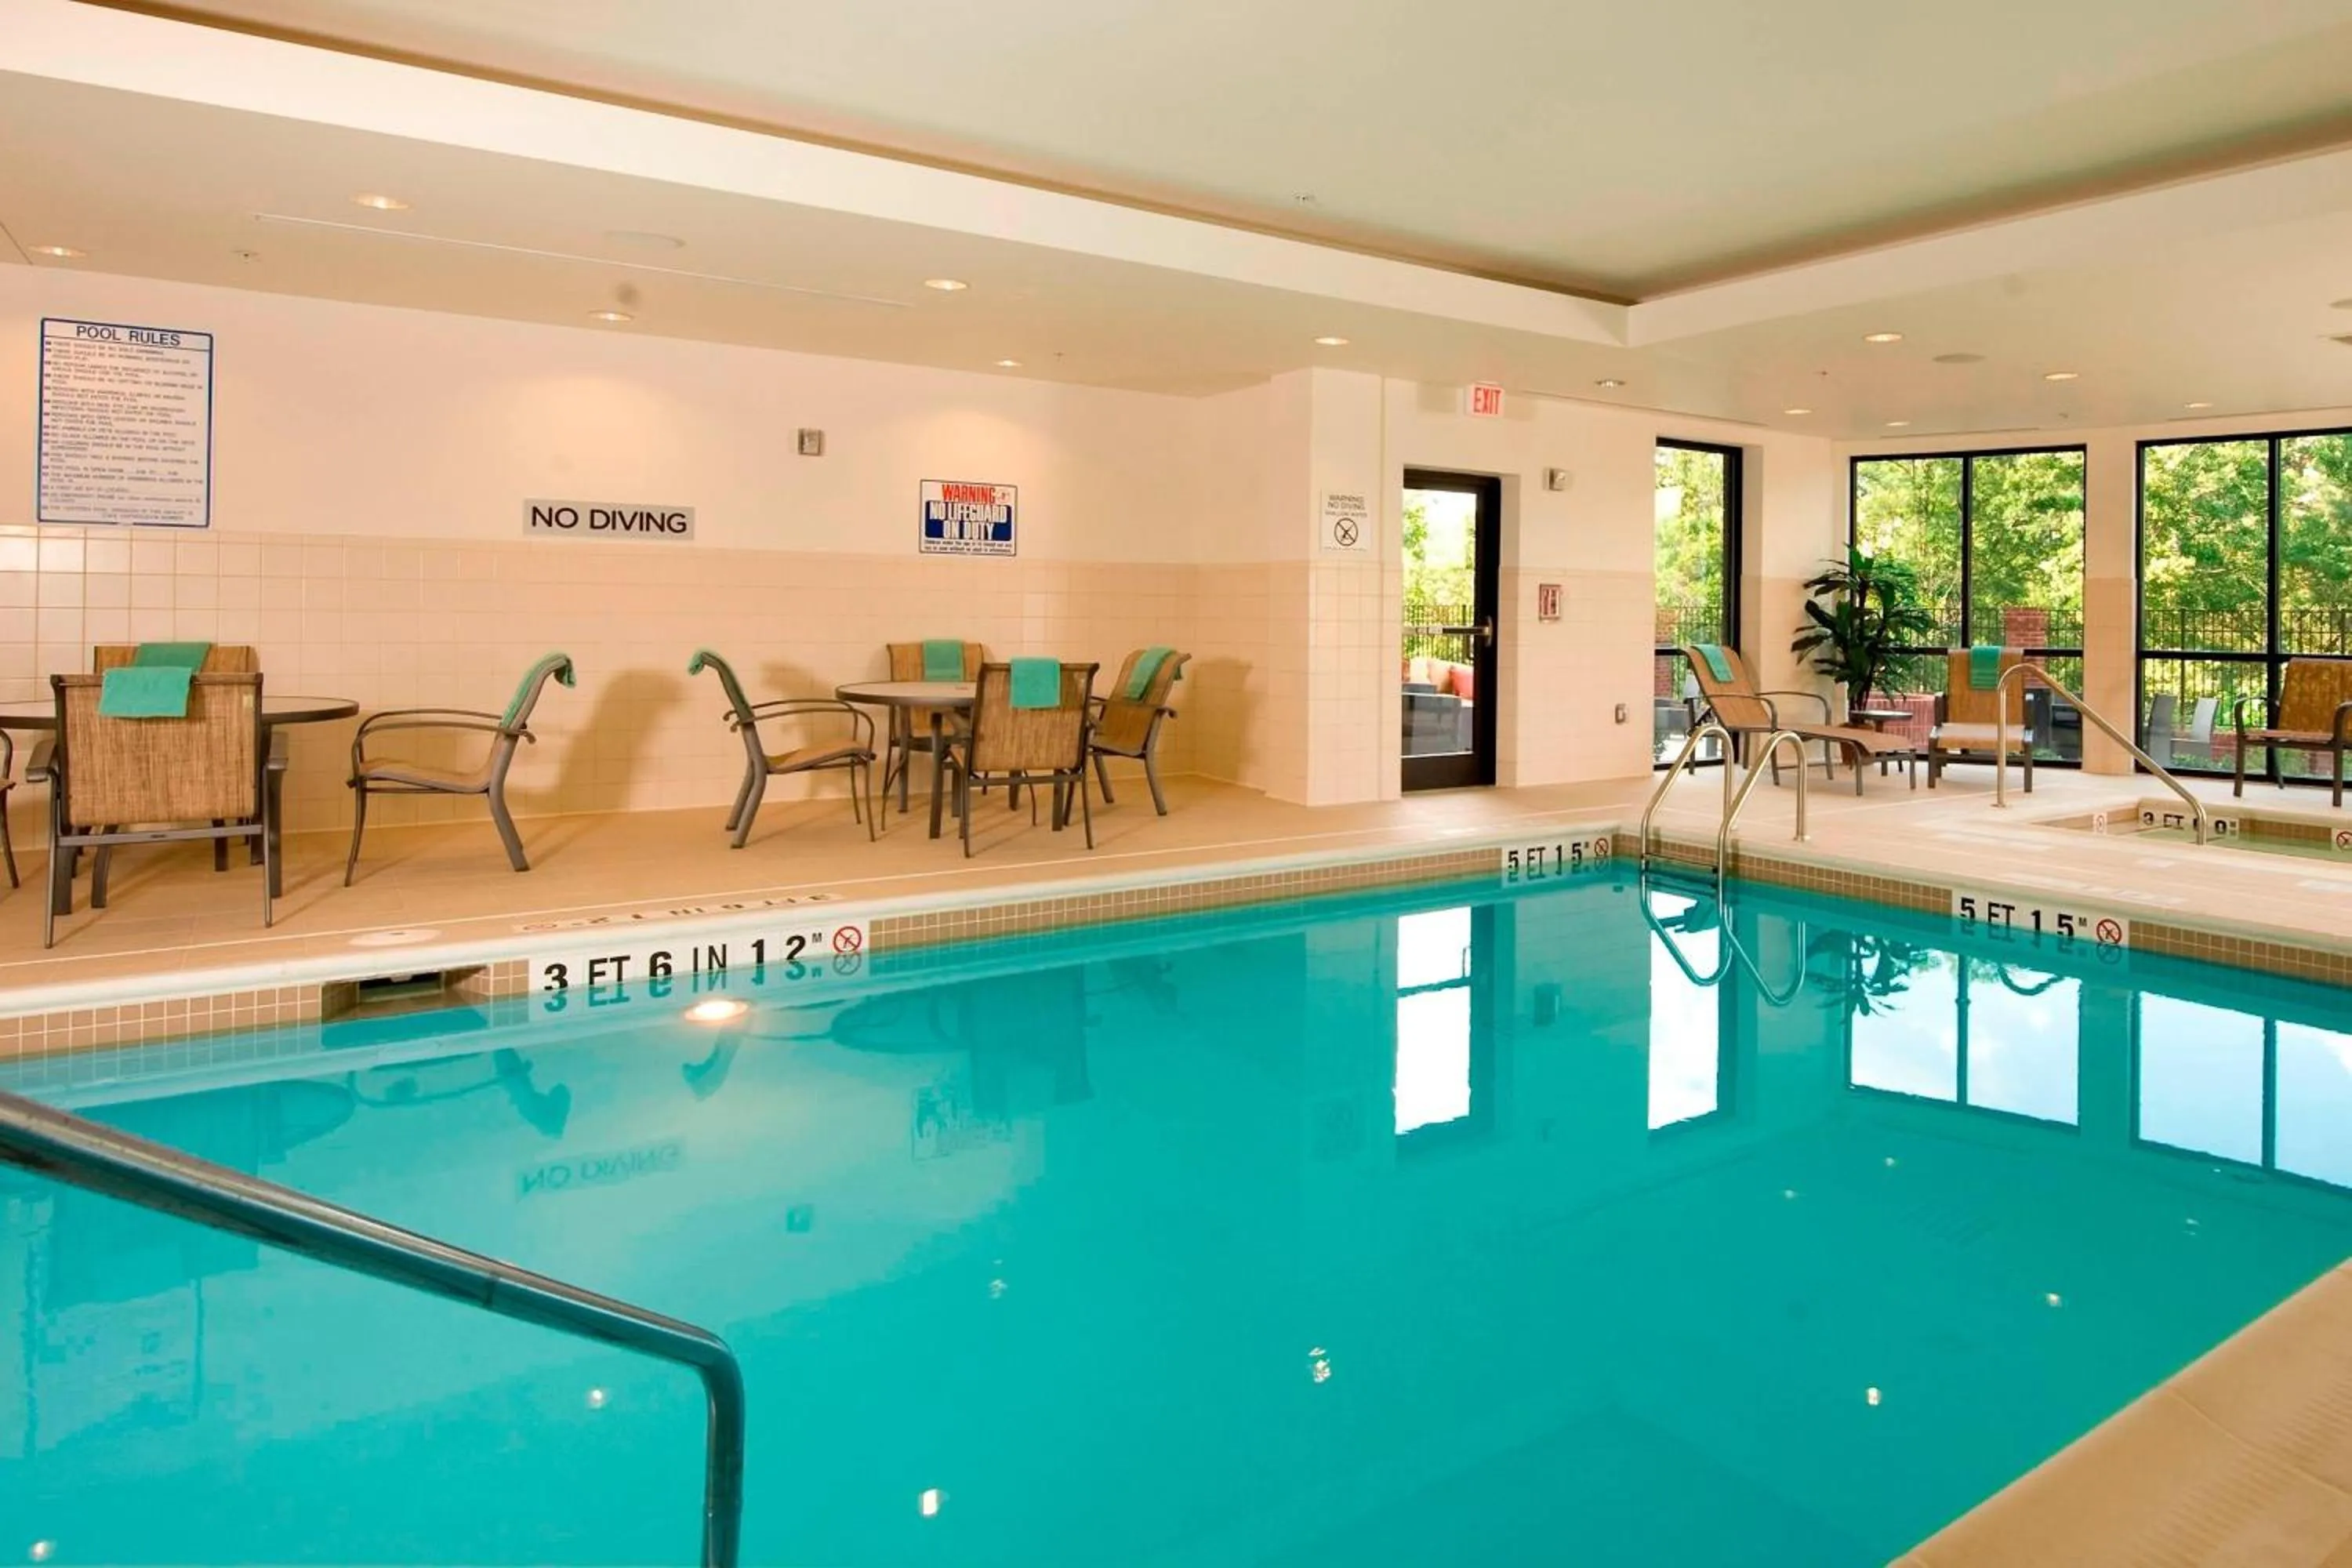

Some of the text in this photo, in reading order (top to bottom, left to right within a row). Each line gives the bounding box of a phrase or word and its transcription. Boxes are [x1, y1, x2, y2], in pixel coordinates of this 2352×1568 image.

[76, 325, 181, 347] POOL RULES
[1474, 387, 1501, 414] EXIT
[942, 484, 996, 504] WARNING
[929, 502, 1007, 523] NO LIFEGUARD
[1327, 501, 1339, 510] NO
[532, 506, 687, 534] NO DIVING
[943, 521, 994, 540] ON DUTY
[1508, 850, 1519, 869] 5
[1527, 847, 1546, 866] FT
[1960, 898, 1976, 920] 5
[1987, 902, 2015, 927] FT
[2031, 910, 2041, 931] 1
[544, 964, 568, 991] 3
[589, 956, 631, 985] FT
[649, 951, 672, 978] 6
[693, 944, 727, 973] IN
[752, 939, 764, 964] 1
